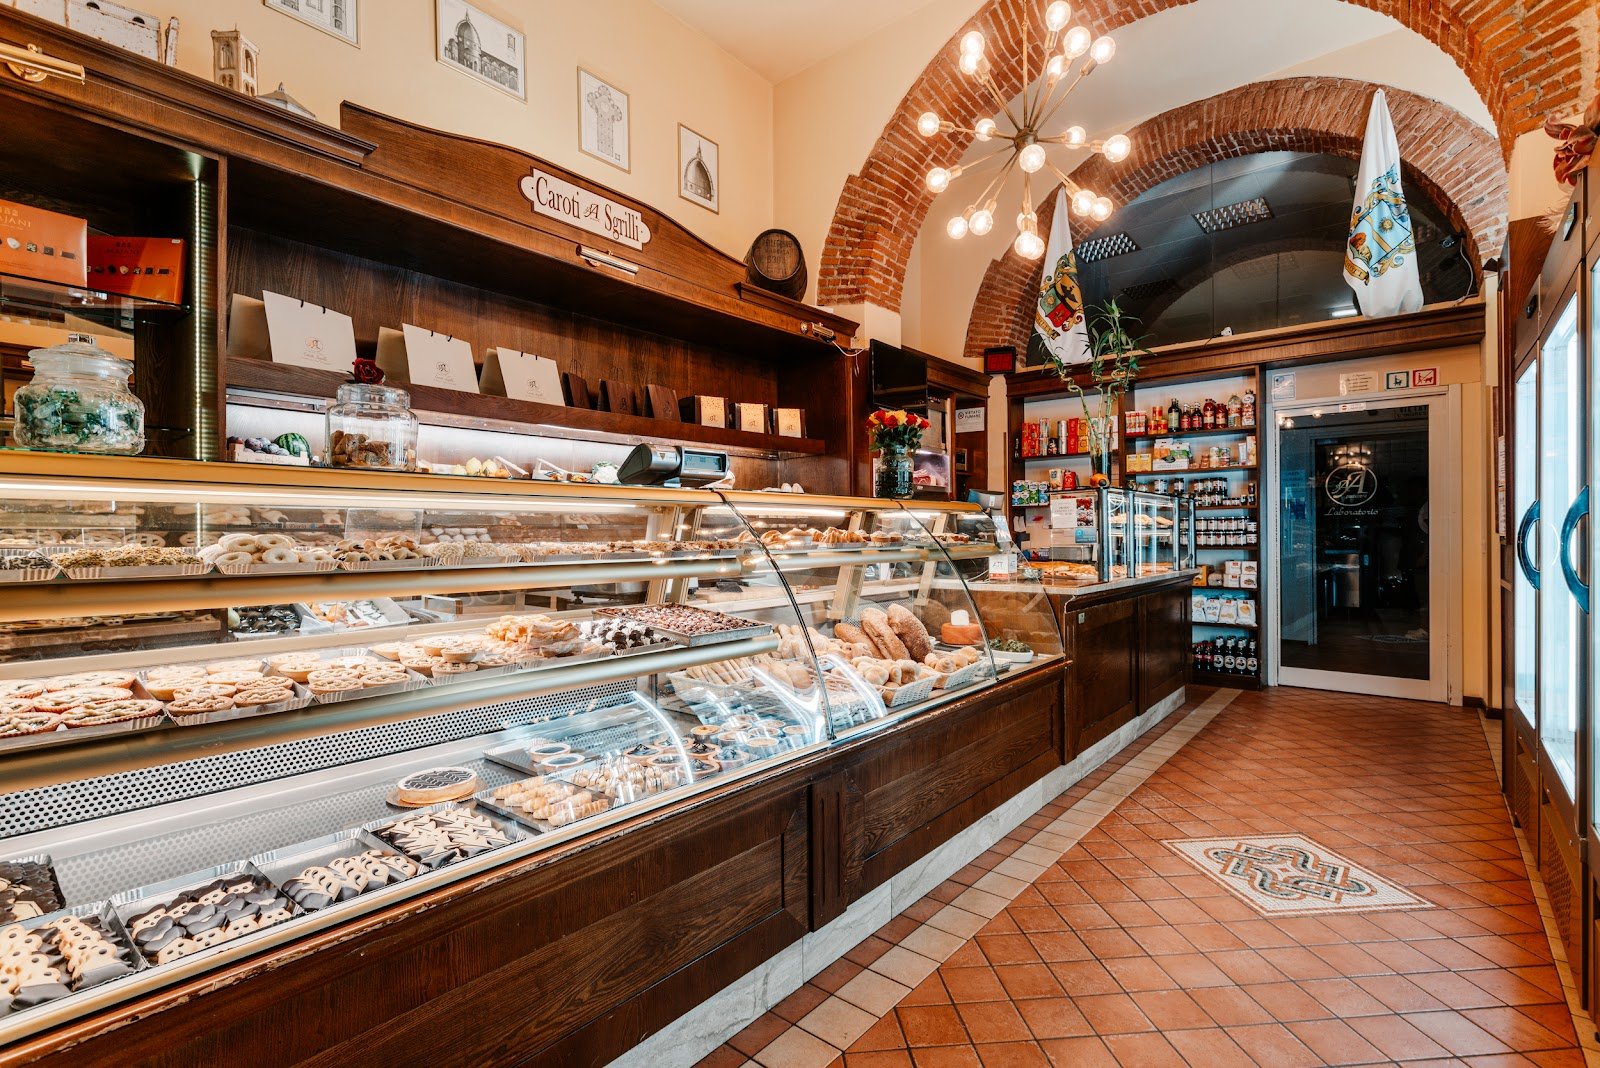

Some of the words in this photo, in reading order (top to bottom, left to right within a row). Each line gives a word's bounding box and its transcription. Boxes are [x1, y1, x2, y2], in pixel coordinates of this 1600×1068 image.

[536, 176, 581, 219] Caroti
[604, 204, 640, 241] Sgrilli
[1324, 507, 1379, 516] Laboratorio
